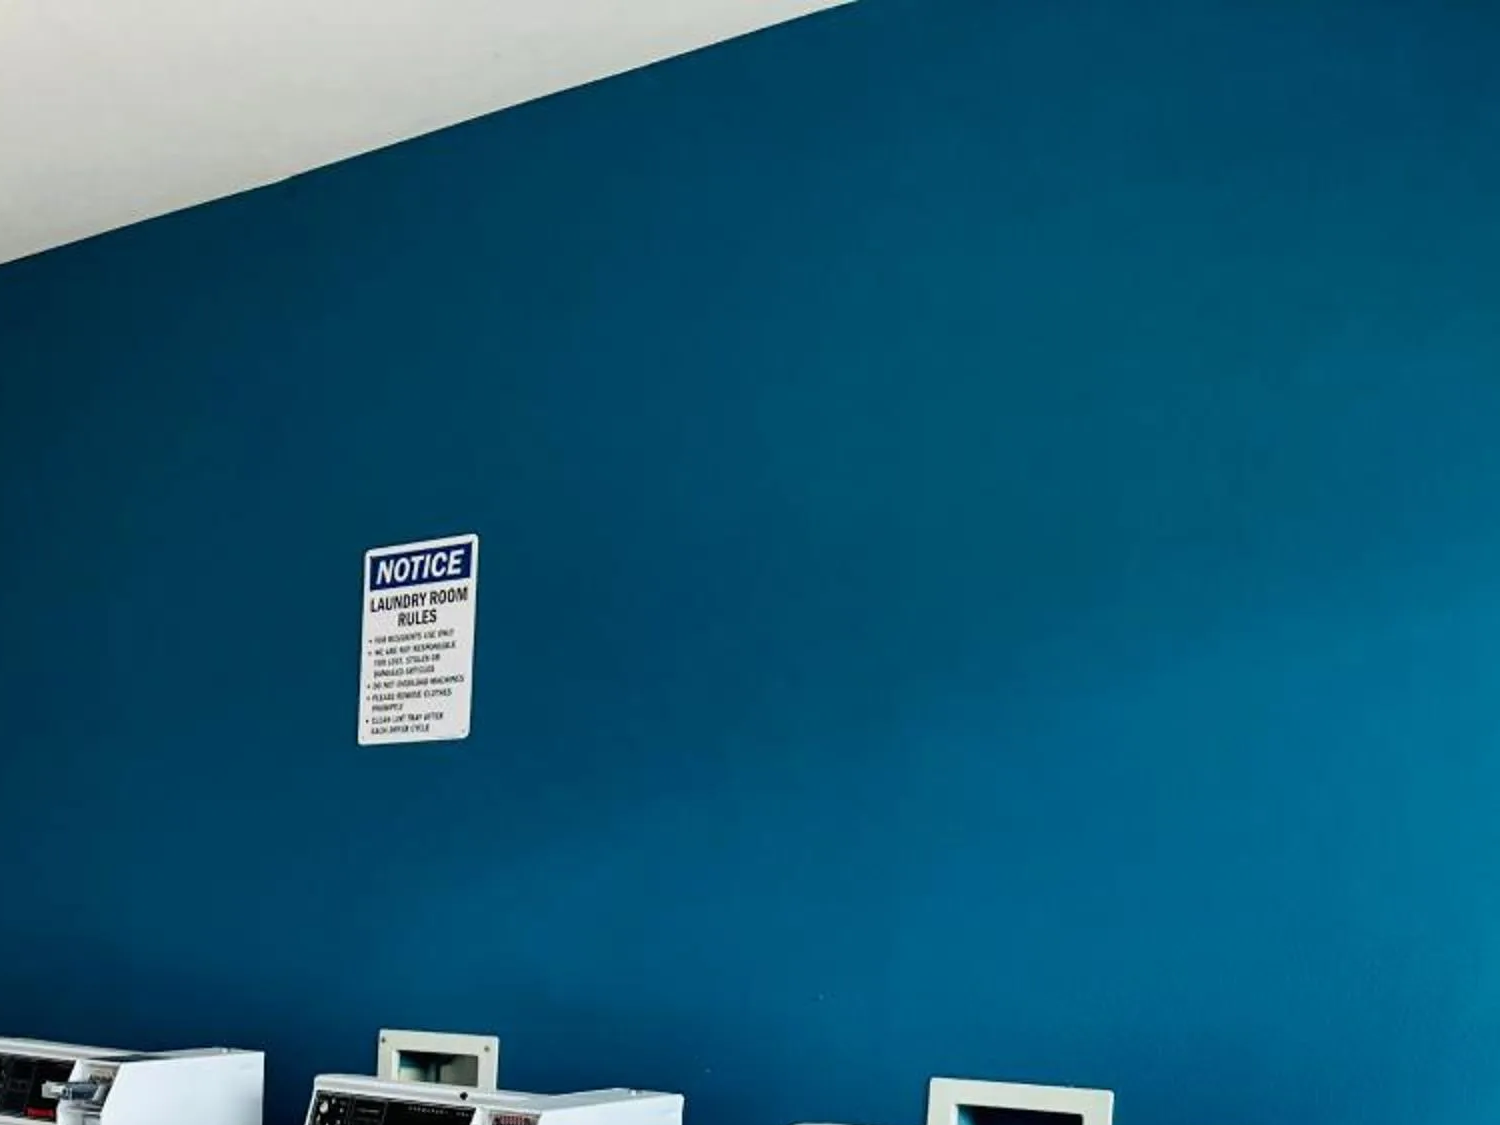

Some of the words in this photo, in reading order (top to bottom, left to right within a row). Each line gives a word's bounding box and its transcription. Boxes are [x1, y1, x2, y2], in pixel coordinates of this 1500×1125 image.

[376, 549, 465, 585] NOTICE
[370, 592, 427, 613] LAUNDRY
[429, 586, 469, 606] ROOM
[397, 608, 438, 627] RULES
